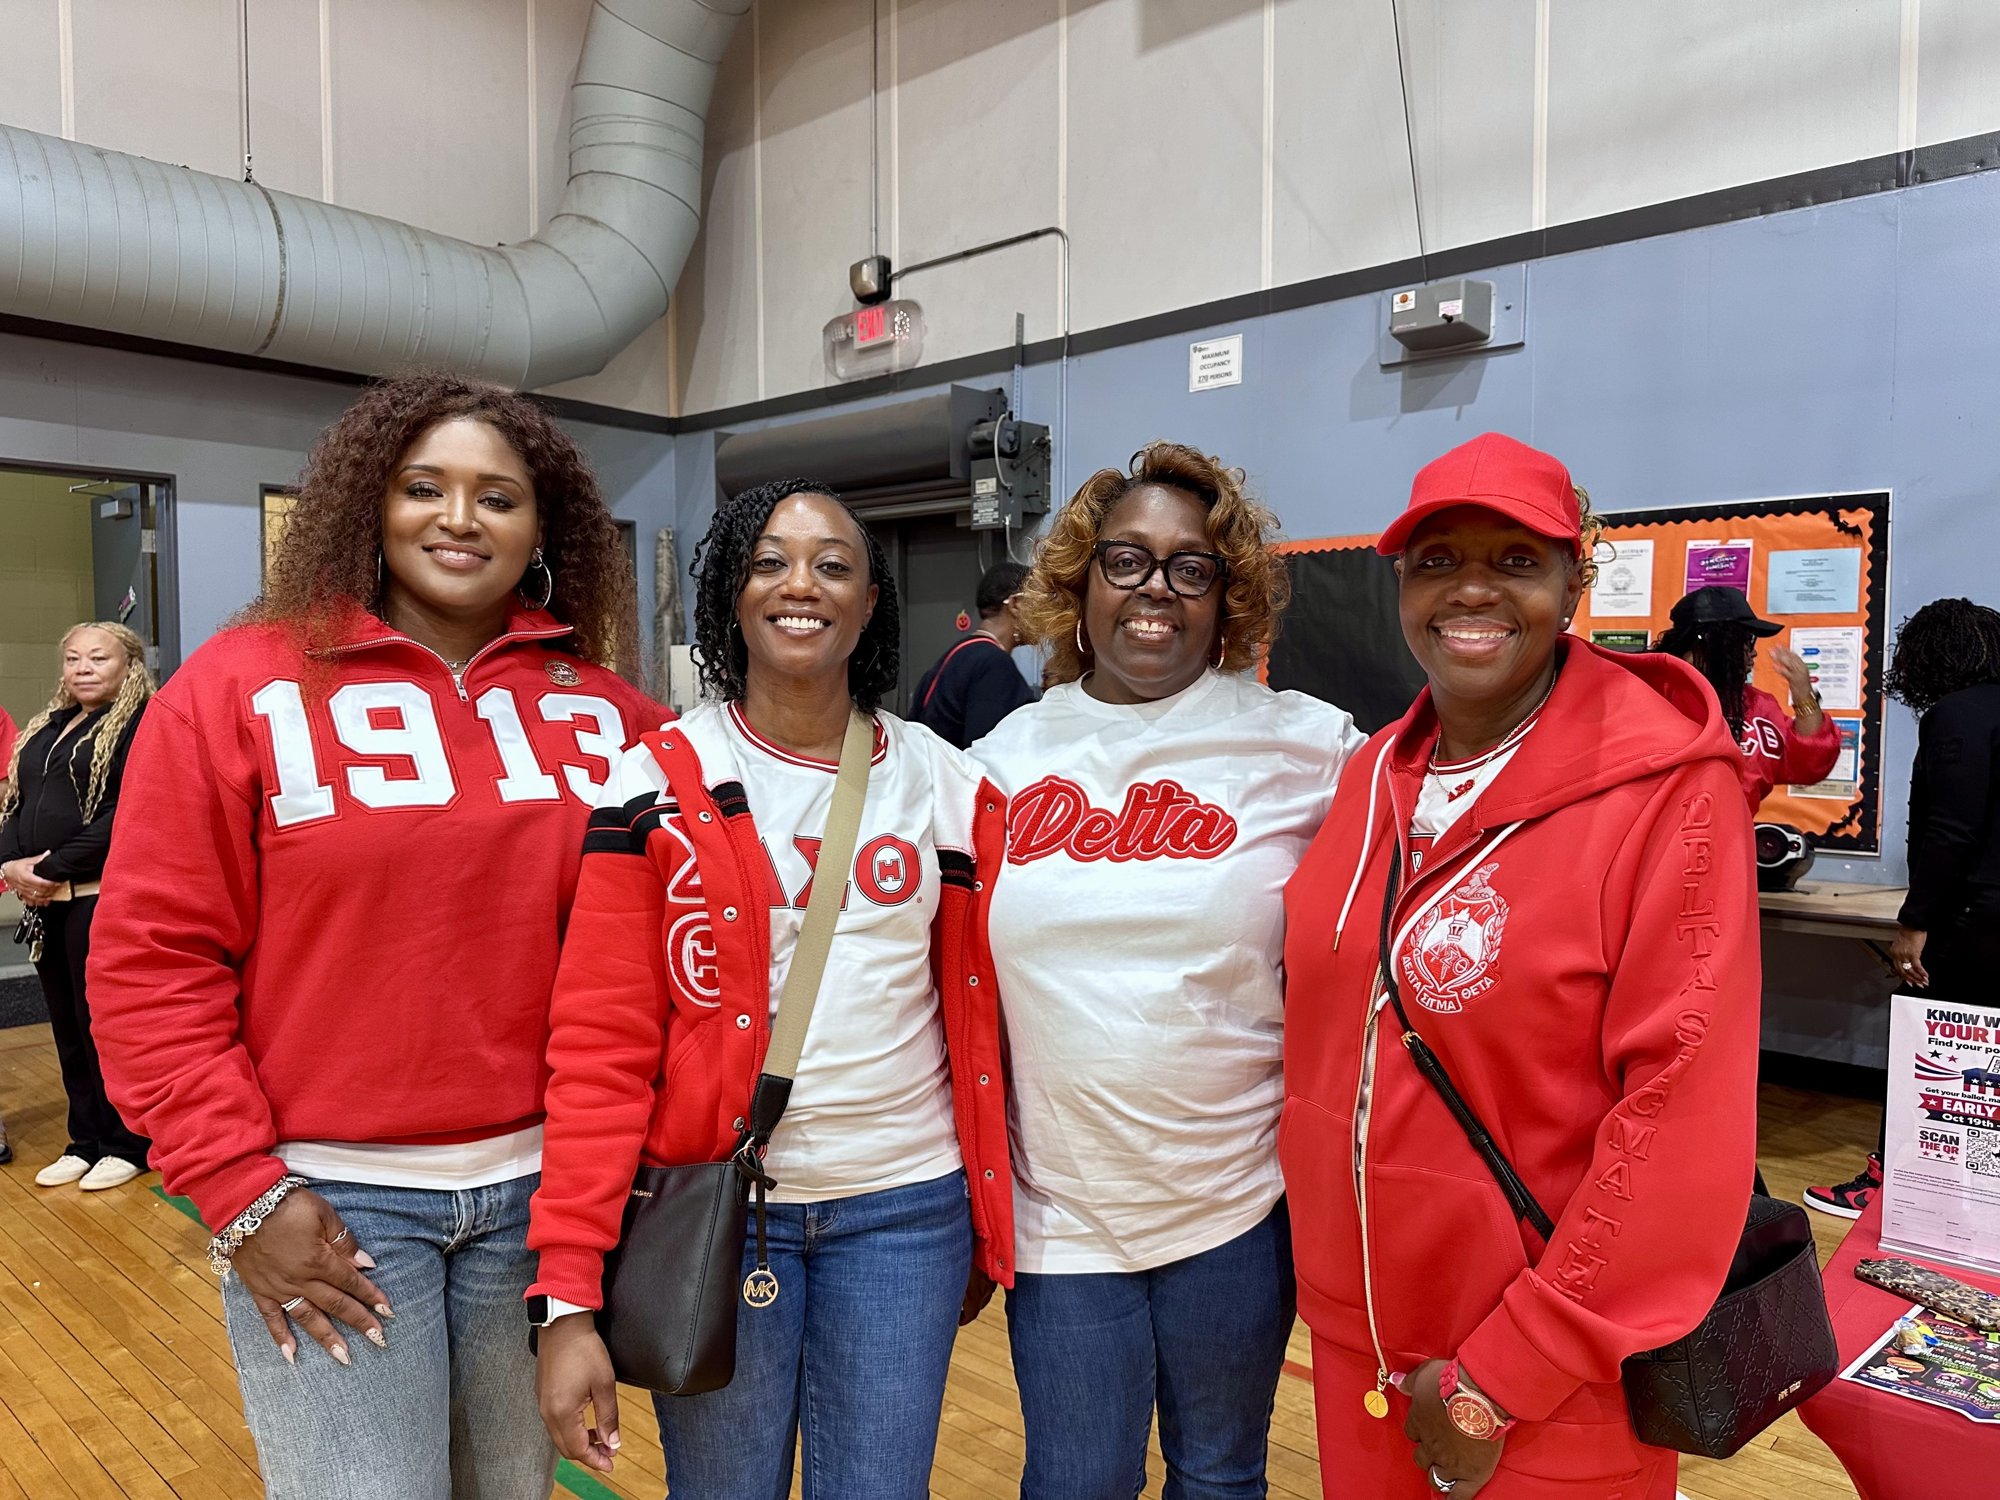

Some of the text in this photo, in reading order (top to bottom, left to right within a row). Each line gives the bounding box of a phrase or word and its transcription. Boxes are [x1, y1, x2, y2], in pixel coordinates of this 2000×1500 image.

[858, 306, 884, 341] EXIT
[1199, 359, 1231, 371] OCCUPANCY
[1209, 371, 1232, 380] PERSONS
[248, 677, 629, 830] 1913
[1007, 775, 1238, 866] Delta
[1926, 1008, 1981, 1026] KNOW
[1924, 1020, 1990, 1044] YOUR
[1928, 1037, 1953, 1047] Find
[1955, 1043, 1983, 1052] your
[1925, 1086, 1939, 1094] Get
[1941, 1089, 1960, 1098] your
[1942, 1098, 1998, 1118] EARLY
[1942, 1113, 1965, 1123] Oct
[1967, 1117, 1994, 1128] 19th
[1919, 1130, 1960, 1146] SCAN
[1919, 1140, 1960, 1155] THE QR
